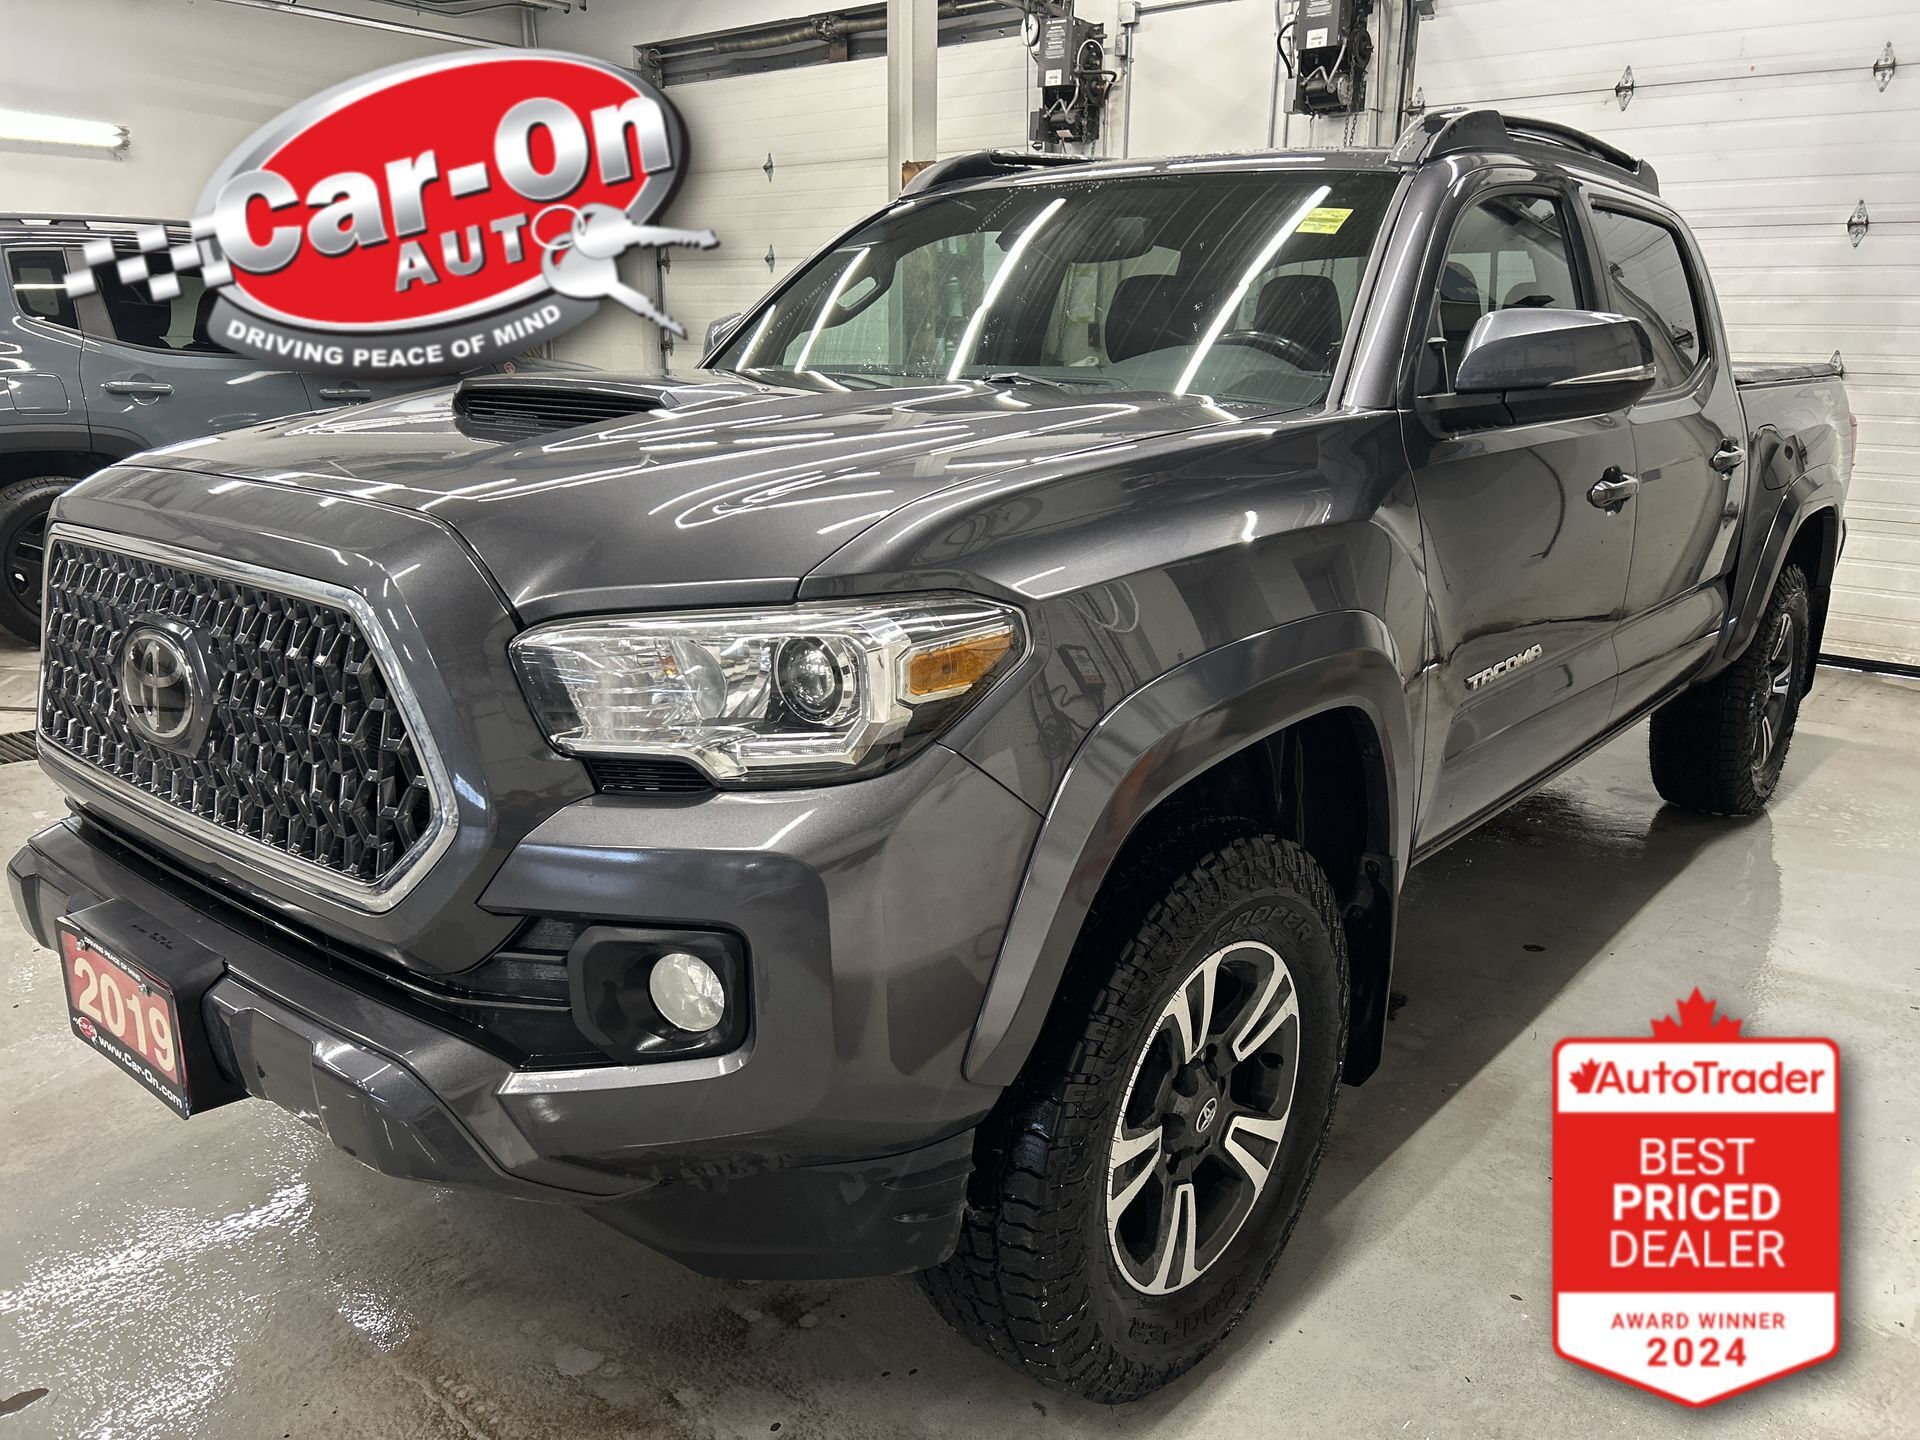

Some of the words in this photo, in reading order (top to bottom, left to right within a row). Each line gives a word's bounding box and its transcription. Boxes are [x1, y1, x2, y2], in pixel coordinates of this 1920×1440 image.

[1466, 643, 1542, 690] TACOMA
[73, 957, 176, 1072] 2019
[97, 1035, 183, 1109] www.Car-On.com
